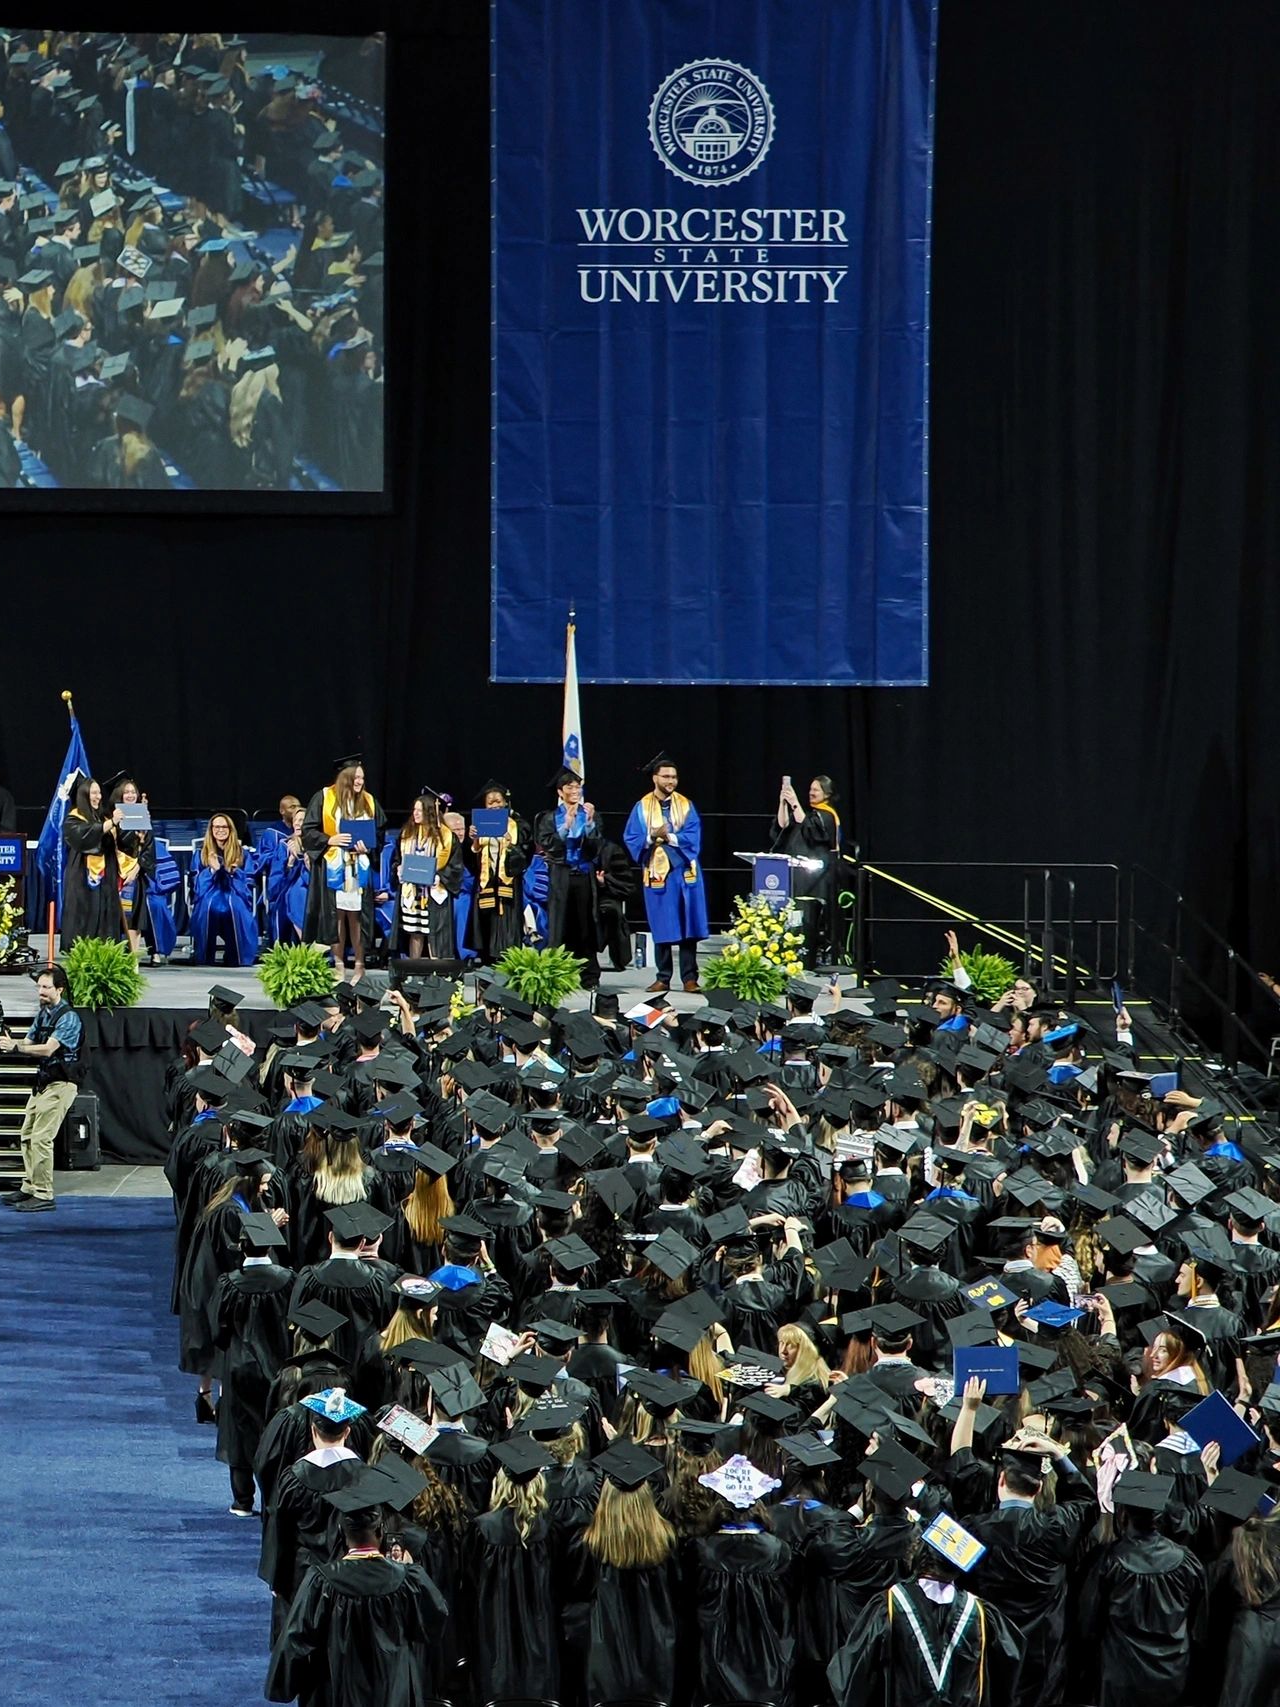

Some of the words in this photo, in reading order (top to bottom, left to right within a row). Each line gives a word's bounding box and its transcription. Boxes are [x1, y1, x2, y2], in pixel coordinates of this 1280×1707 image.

[657, 76, 690, 156] WORCESTER
[692, 67, 733, 82] STATE
[735, 76, 766, 156] UNIVERSITY
[697, 163, 729, 177] 1874
[576, 208, 847, 242] WORCESTER
[654, 248, 769, 264] STATE
[577, 269, 848, 304] UNIVERSITY
